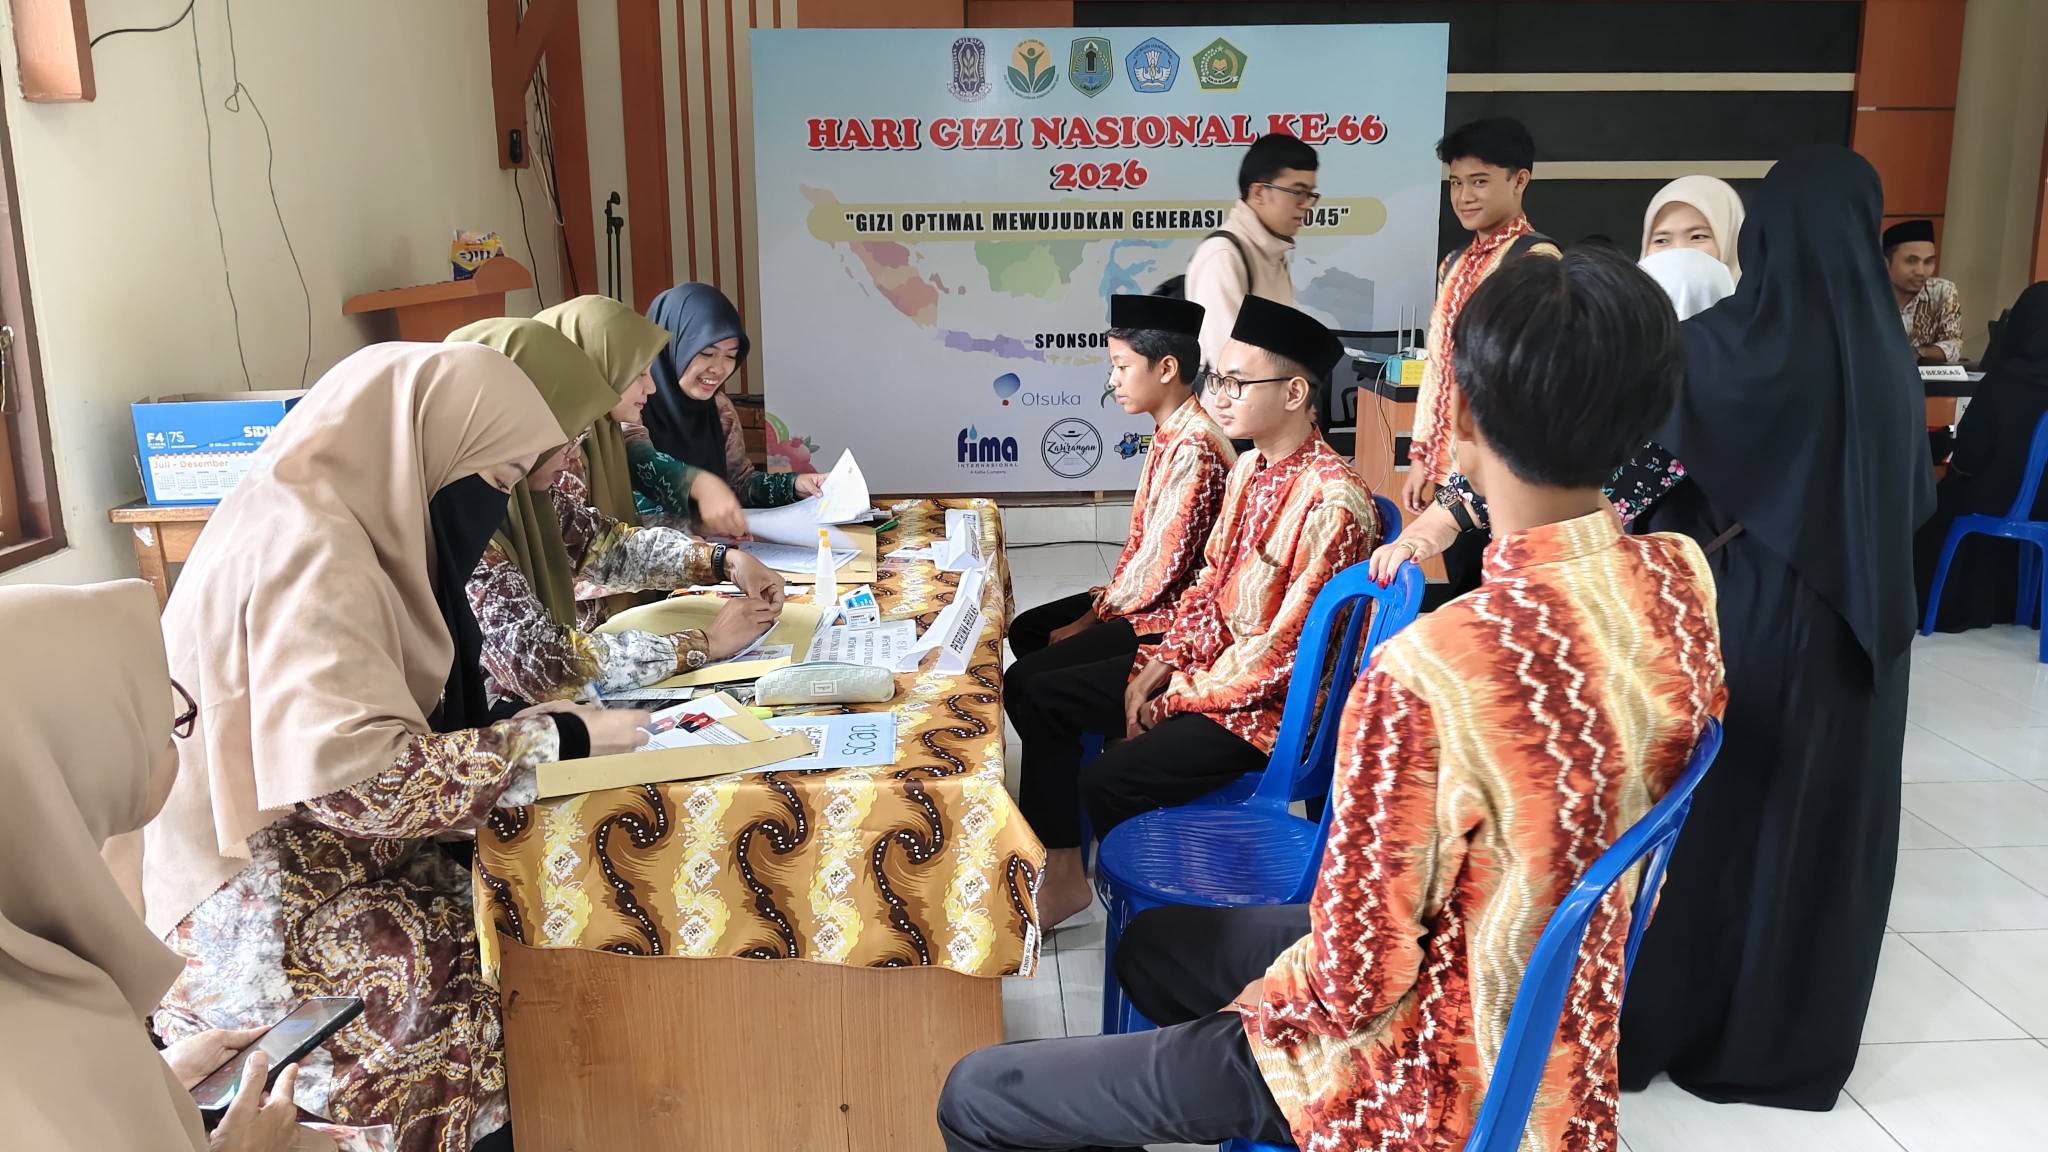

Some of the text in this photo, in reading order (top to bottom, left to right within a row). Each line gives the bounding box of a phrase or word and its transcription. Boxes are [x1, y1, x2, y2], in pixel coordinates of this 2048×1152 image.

[807, 112, 1388, 150] HARI GIZI NASIONAL KE-66
[1050, 159, 1148, 191] 2026
[846, 207, 1349, 232] "GIZI OPTIMAL MEWUJUDKAN GENERASI 045"
[1021, 391, 1081, 406] Otsuka
[146, 431, 185, 443] F4 75
[957, 424, 1019, 463] fima
[180, 459, 229, 468] Desember
